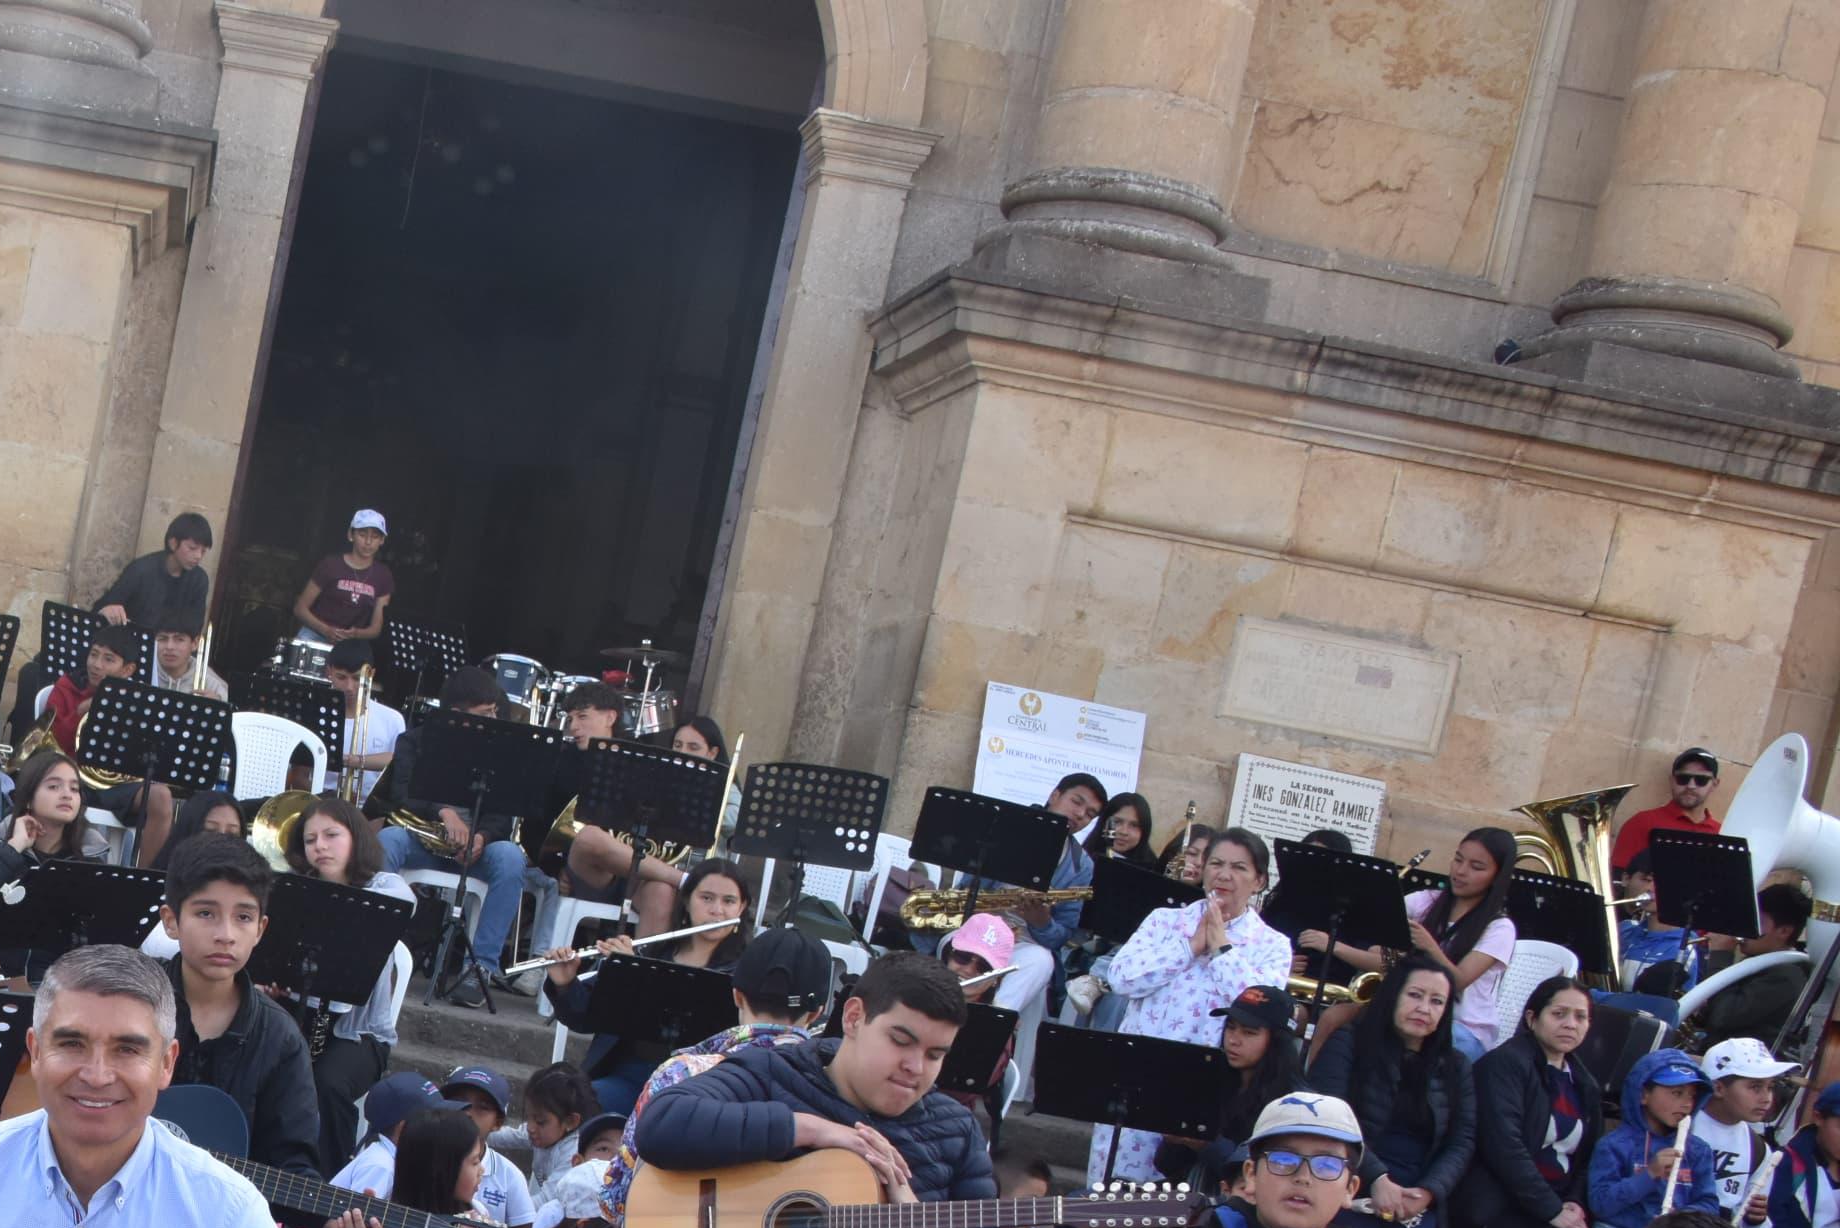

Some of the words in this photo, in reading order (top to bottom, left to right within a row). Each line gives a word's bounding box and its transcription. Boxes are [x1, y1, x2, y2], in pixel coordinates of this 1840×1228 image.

[1007, 714, 1048, 733] CENTRAL
[1290, 781, 1301, 790] LA
[1252, 783, 1274, 802] INES
[1280, 789, 1327, 814] GONZALEZ
[1332, 800, 1375, 823] RAMIREZ
[1724, 1178, 1740, 1195] SB
